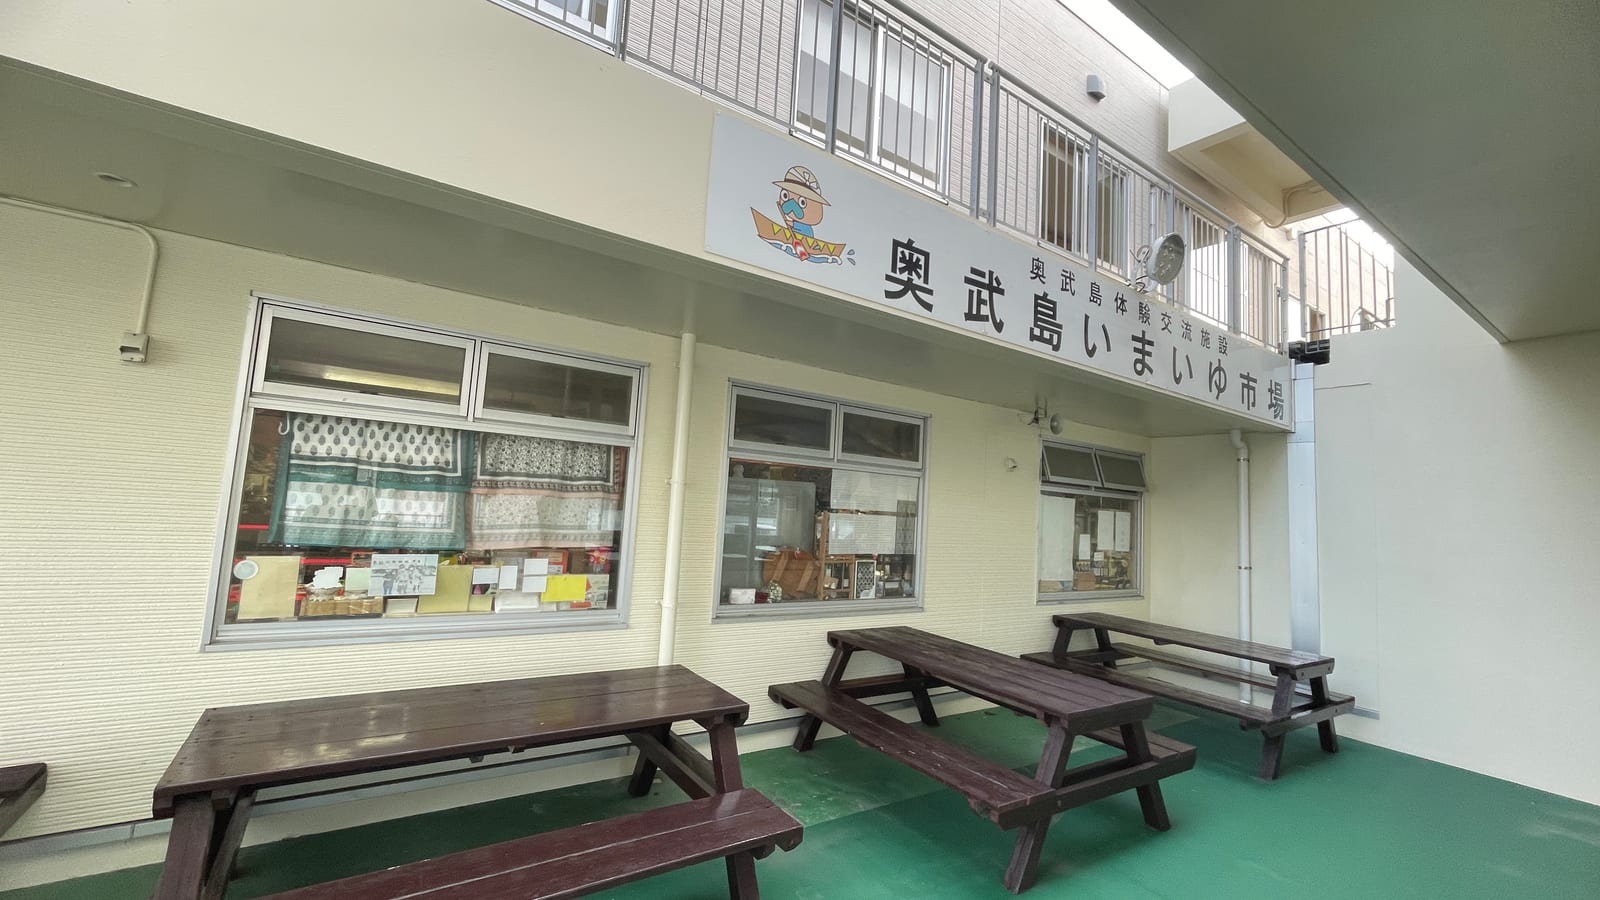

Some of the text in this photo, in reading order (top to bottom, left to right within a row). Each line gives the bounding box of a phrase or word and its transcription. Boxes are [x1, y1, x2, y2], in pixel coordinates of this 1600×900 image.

[884, 238, 1284, 420] 奥武島いまいゆ市場
[1030, 257, 1228, 356] 奥武島体験交流施設
